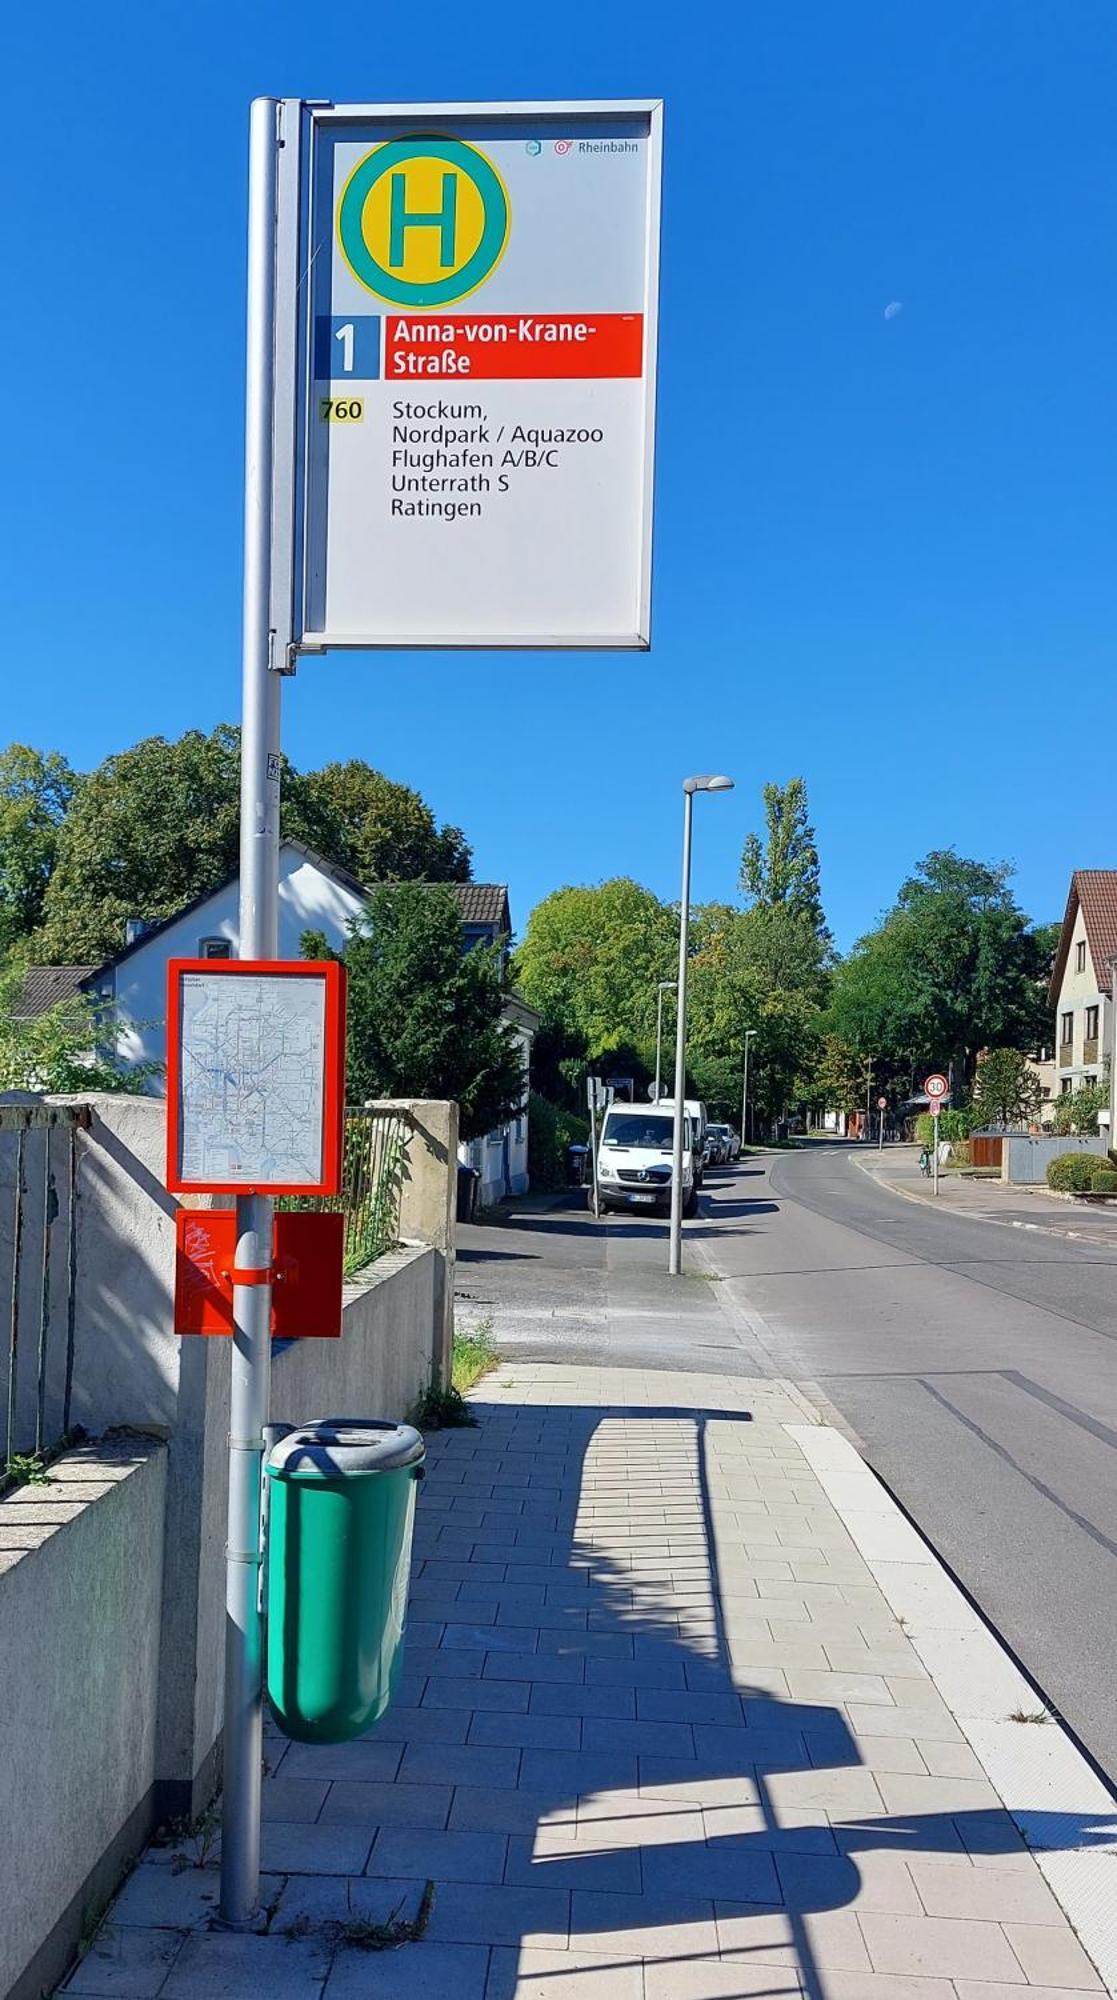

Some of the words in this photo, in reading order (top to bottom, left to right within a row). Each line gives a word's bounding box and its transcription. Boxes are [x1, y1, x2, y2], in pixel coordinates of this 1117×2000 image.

[579, 141, 638, 153] Rheinbahn
[389, 172, 457, 268] H
[393, 320, 597, 343] Anna-von-Krane-
[335, 323, 355, 372] 1
[393, 349, 471, 374] Straße
[321, 402, 362, 419] 760
[393, 401, 488, 421] Stockum,
[393, 425, 489, 448] Nordpark
[496, 426, 505, 443] /
[511, 426, 604, 447] Aquazoo
[392, 449, 493, 472] Flughafen
[500, 450, 559, 468] A/B/C
[392, 474, 490, 492] Unterrath
[499, 475, 509, 492] S
[391, 498, 482, 521] Ratingen
[930, 1082, 942, 1092] 30
